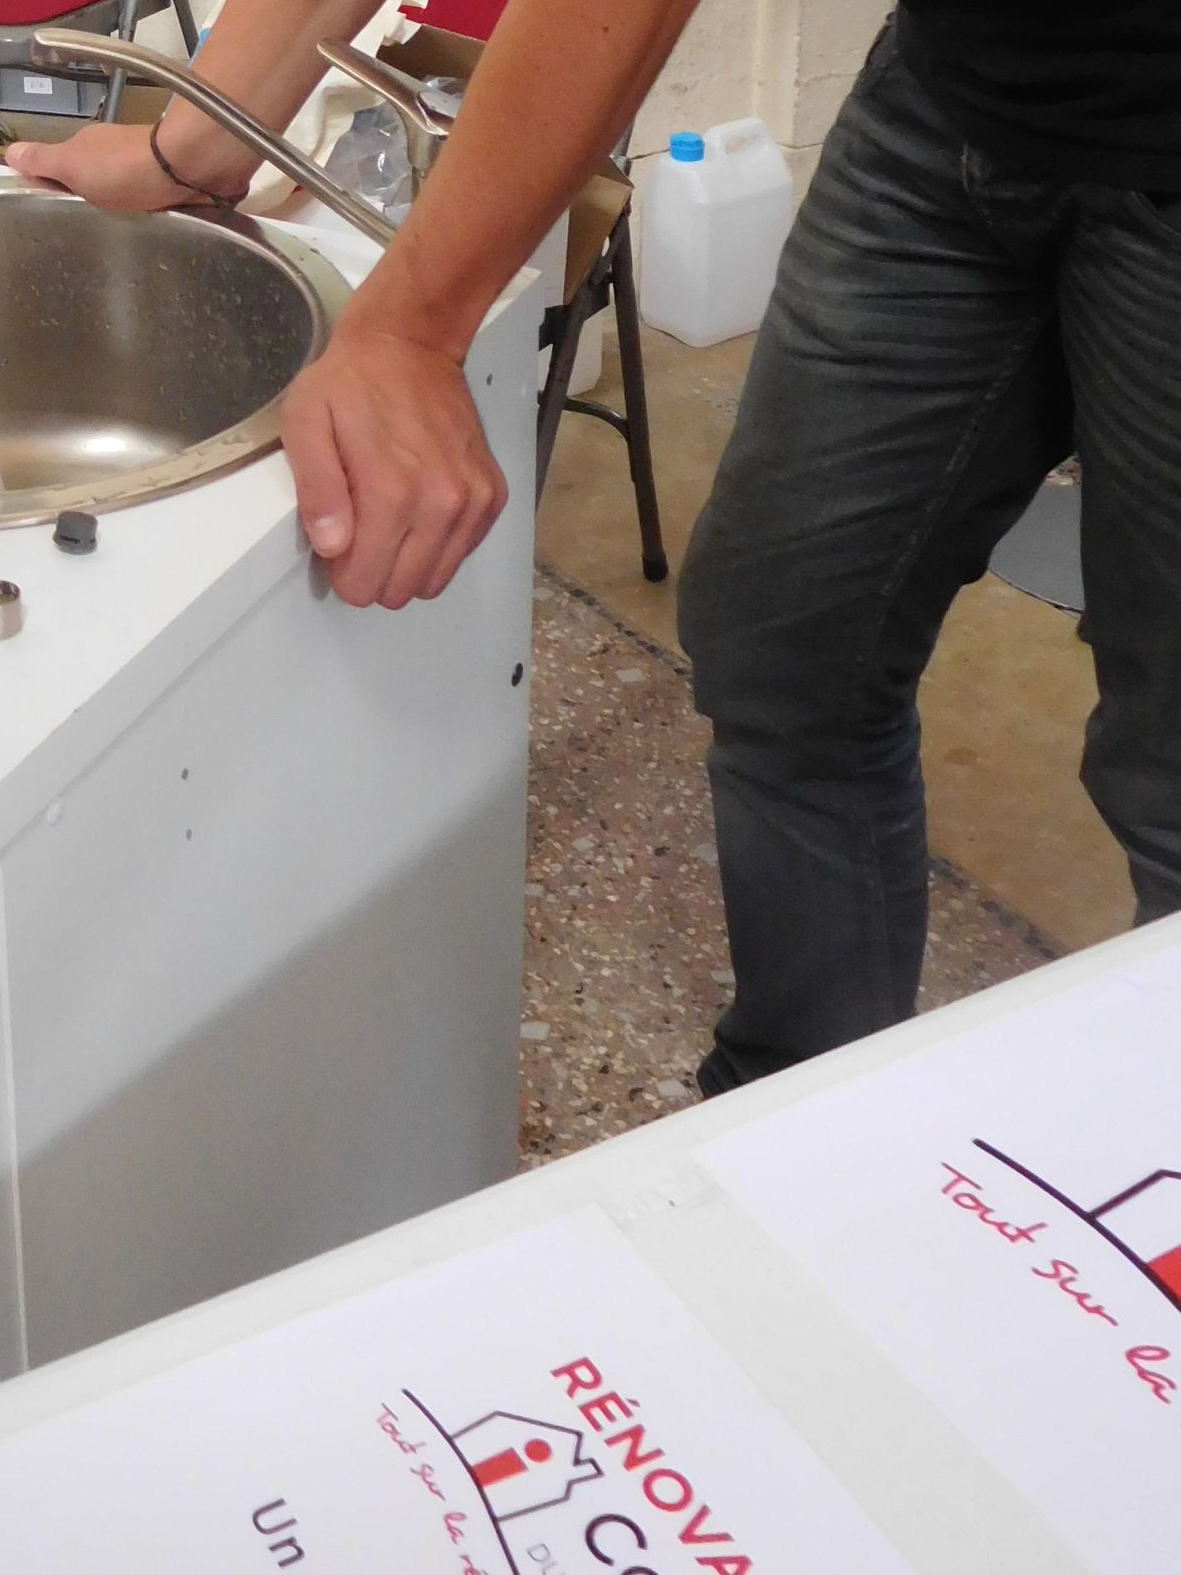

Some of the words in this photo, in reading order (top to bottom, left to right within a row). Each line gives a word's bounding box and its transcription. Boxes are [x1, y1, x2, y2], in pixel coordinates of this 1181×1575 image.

[939, 1158, 1049, 1245] Tout
[1123, 1343, 1178, 1406] la
[375, 1400, 428, 1456] Tout
[250, 1496, 307, 1570] Un
